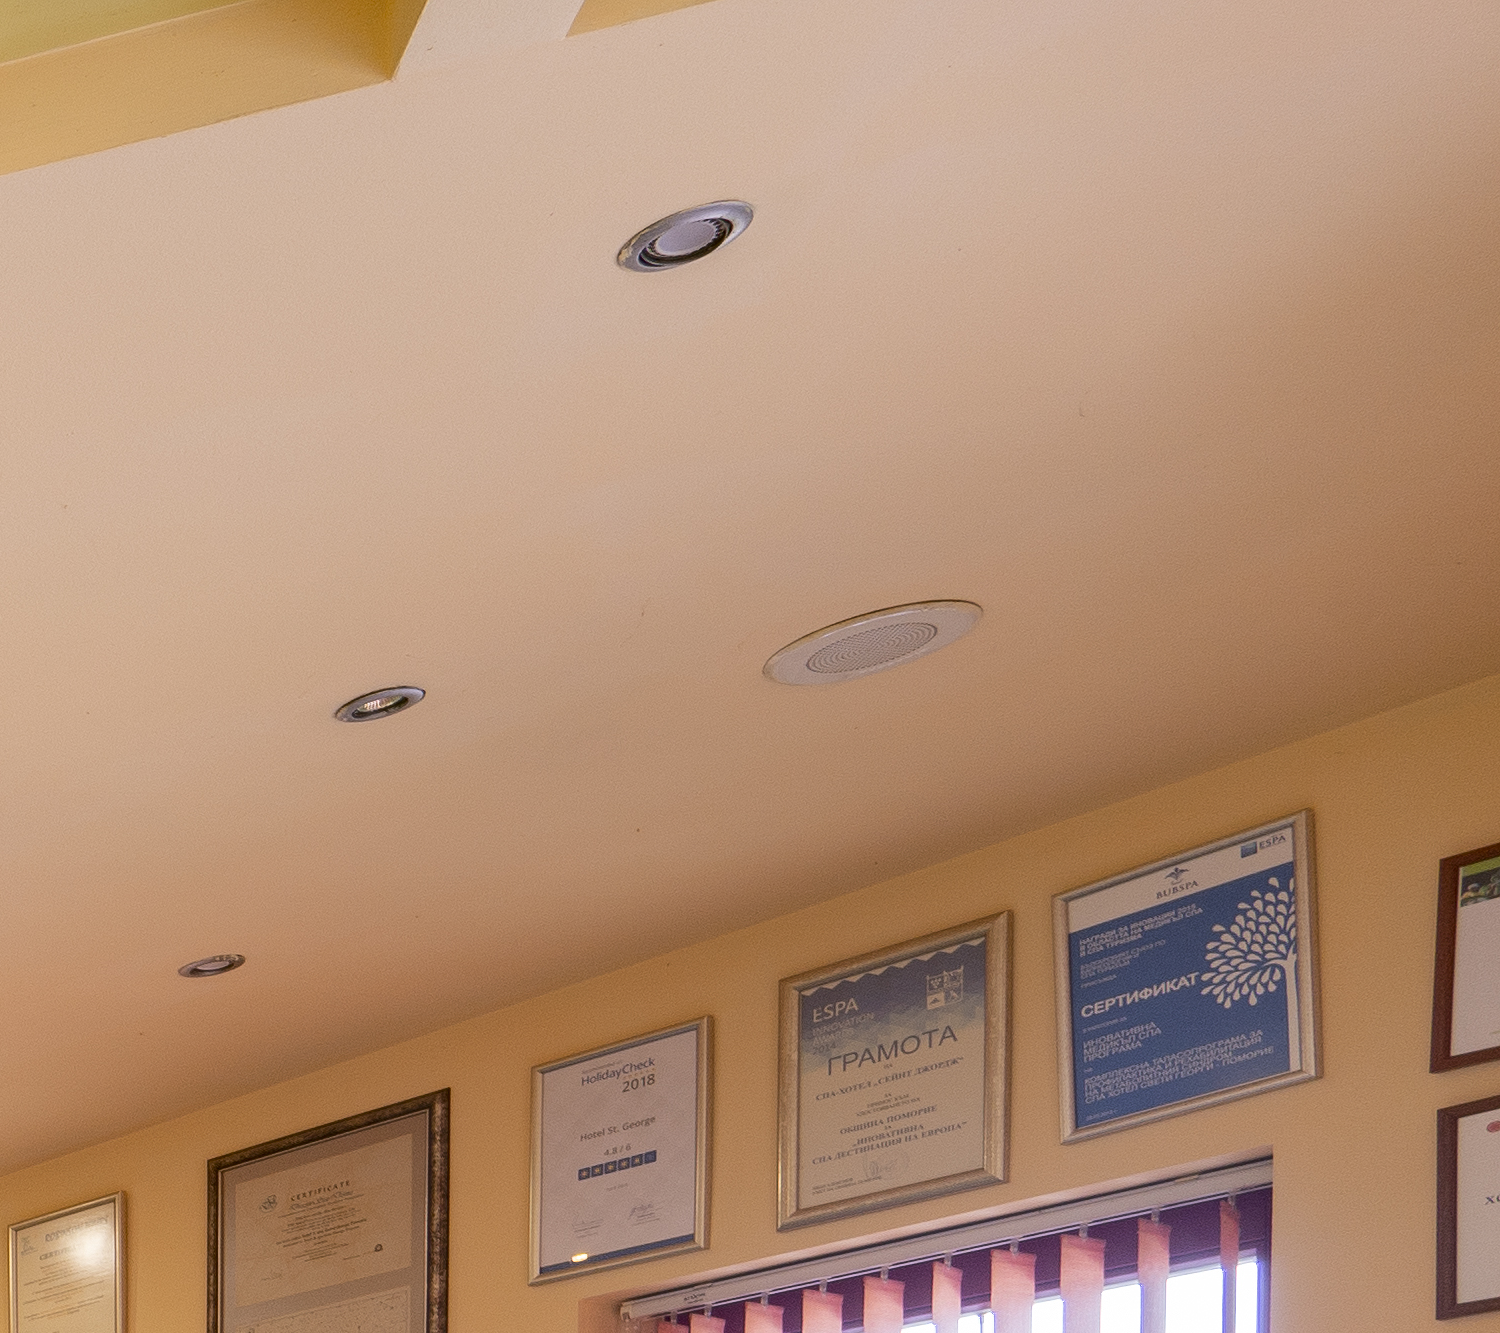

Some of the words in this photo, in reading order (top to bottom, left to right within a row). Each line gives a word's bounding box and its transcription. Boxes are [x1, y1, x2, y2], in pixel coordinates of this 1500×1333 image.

[1260, 832, 1286, 851] ESPA
[1156, 879, 1199, 899] BUBSPA
[1081, 972, 1199, 1017] СЕРТИФИКАТ
[813, 998, 858, 1023] ESPA
[1083, 1022, 1157, 1049] ИНОВАТИВНА
[1138, 1028, 1161, 1040] СПА
[827, 1025, 957, 1076] ГРАМОТА
[581, 1057, 655, 1086] HolidayCheck
[622, 1074, 656, 1092] 2018
[580, 1128, 605, 1142] Hotel
[608, 1124, 620, 1135] St.
[622, 1115, 656, 1131] George
[291, 1181, 349, 1201] CERTIFICATE
